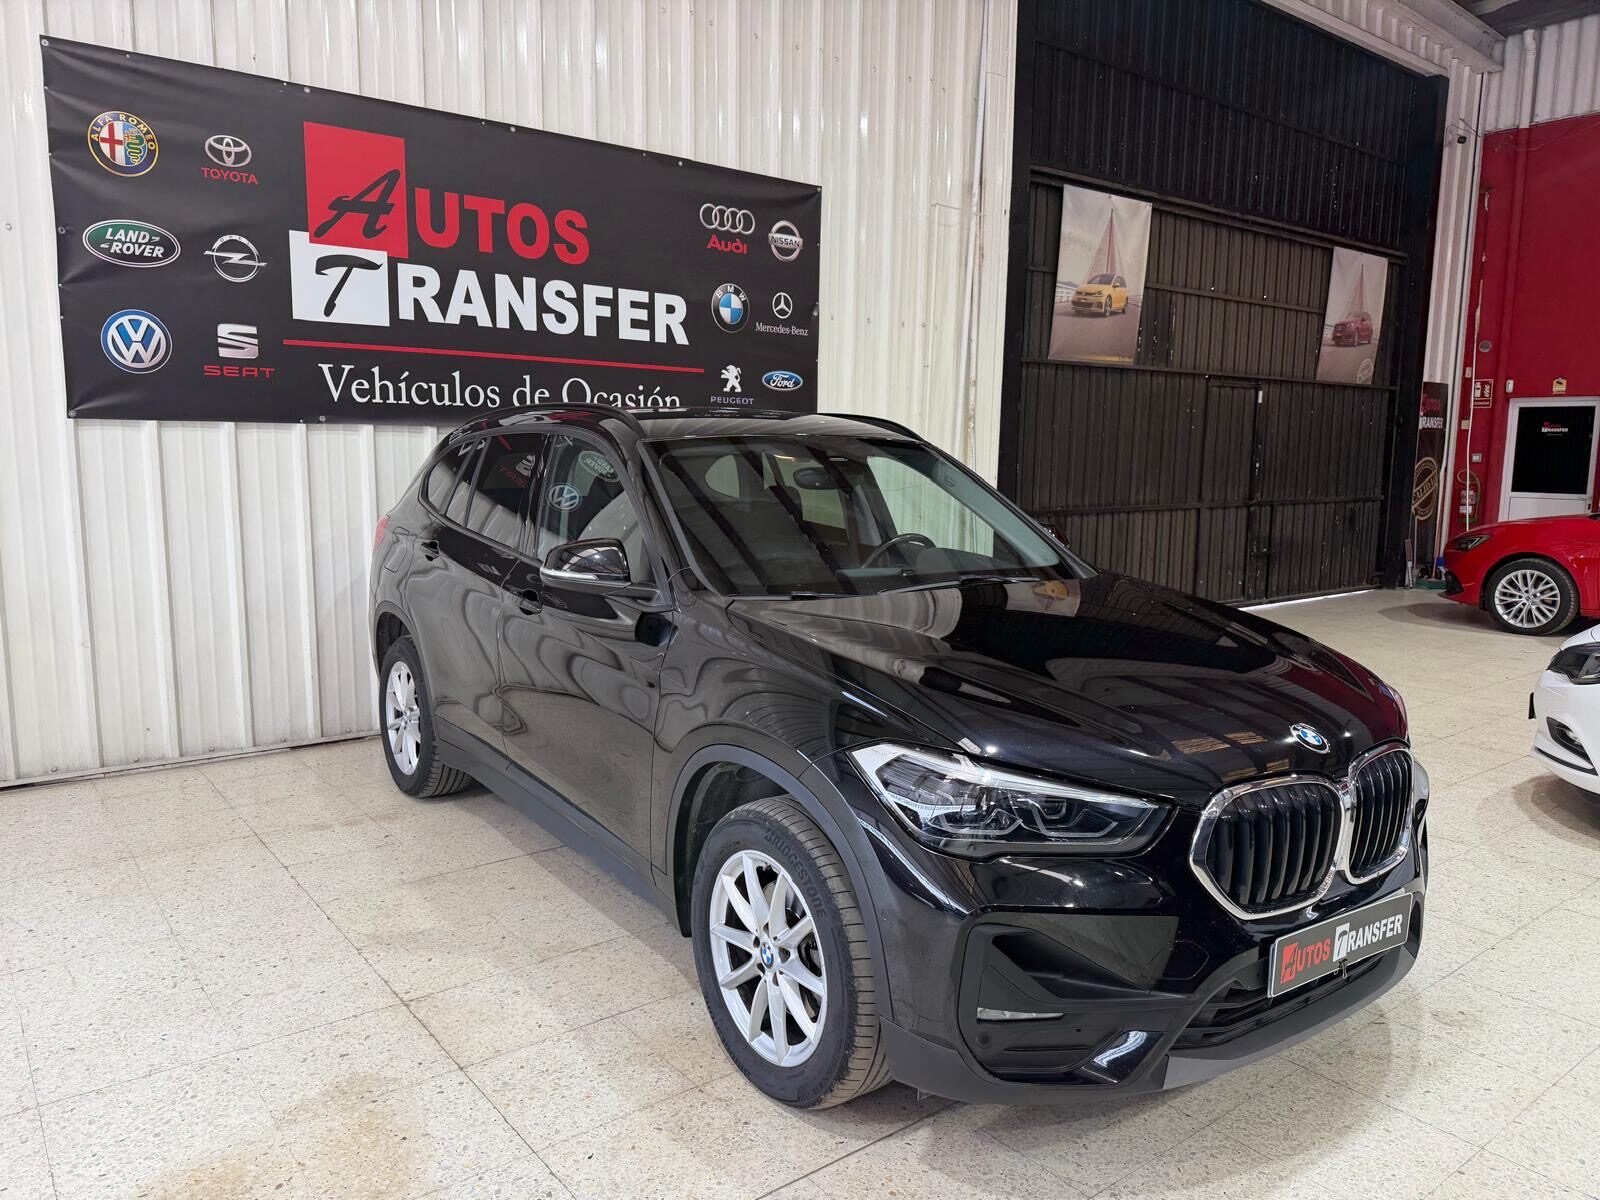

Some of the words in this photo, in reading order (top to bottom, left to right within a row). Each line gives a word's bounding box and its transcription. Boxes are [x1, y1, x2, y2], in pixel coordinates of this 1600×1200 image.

[91, 115, 113, 141] ALFA
[119, 114, 156, 150] ROMEO
[201, 167, 258, 185] TOYOTA
[313, 168, 590, 265] AUTOS
[105, 227, 151, 244] LAND
[706, 234, 748, 255] Audi
[770, 234, 801, 248] NISSAN
[110, 242, 165, 259] ROVER
[314, 254, 690, 346] TRANSFER
[755, 322, 809, 337] Mercedes-Benz
[203, 365, 275, 379] SEAT
[318, 363, 500, 408] Vehículos
[512, 374, 550, 407] de
[561, 377, 681, 408] Ocasión
[769, 374, 795, 389] Ford
[710, 395, 754, 405] PEUGEOT
[763, 828, 827, 918] BRIDGESTONE
[1280, 938, 1332, 984] AUTOS
[1332, 914, 1403, 962] TRANSFER
